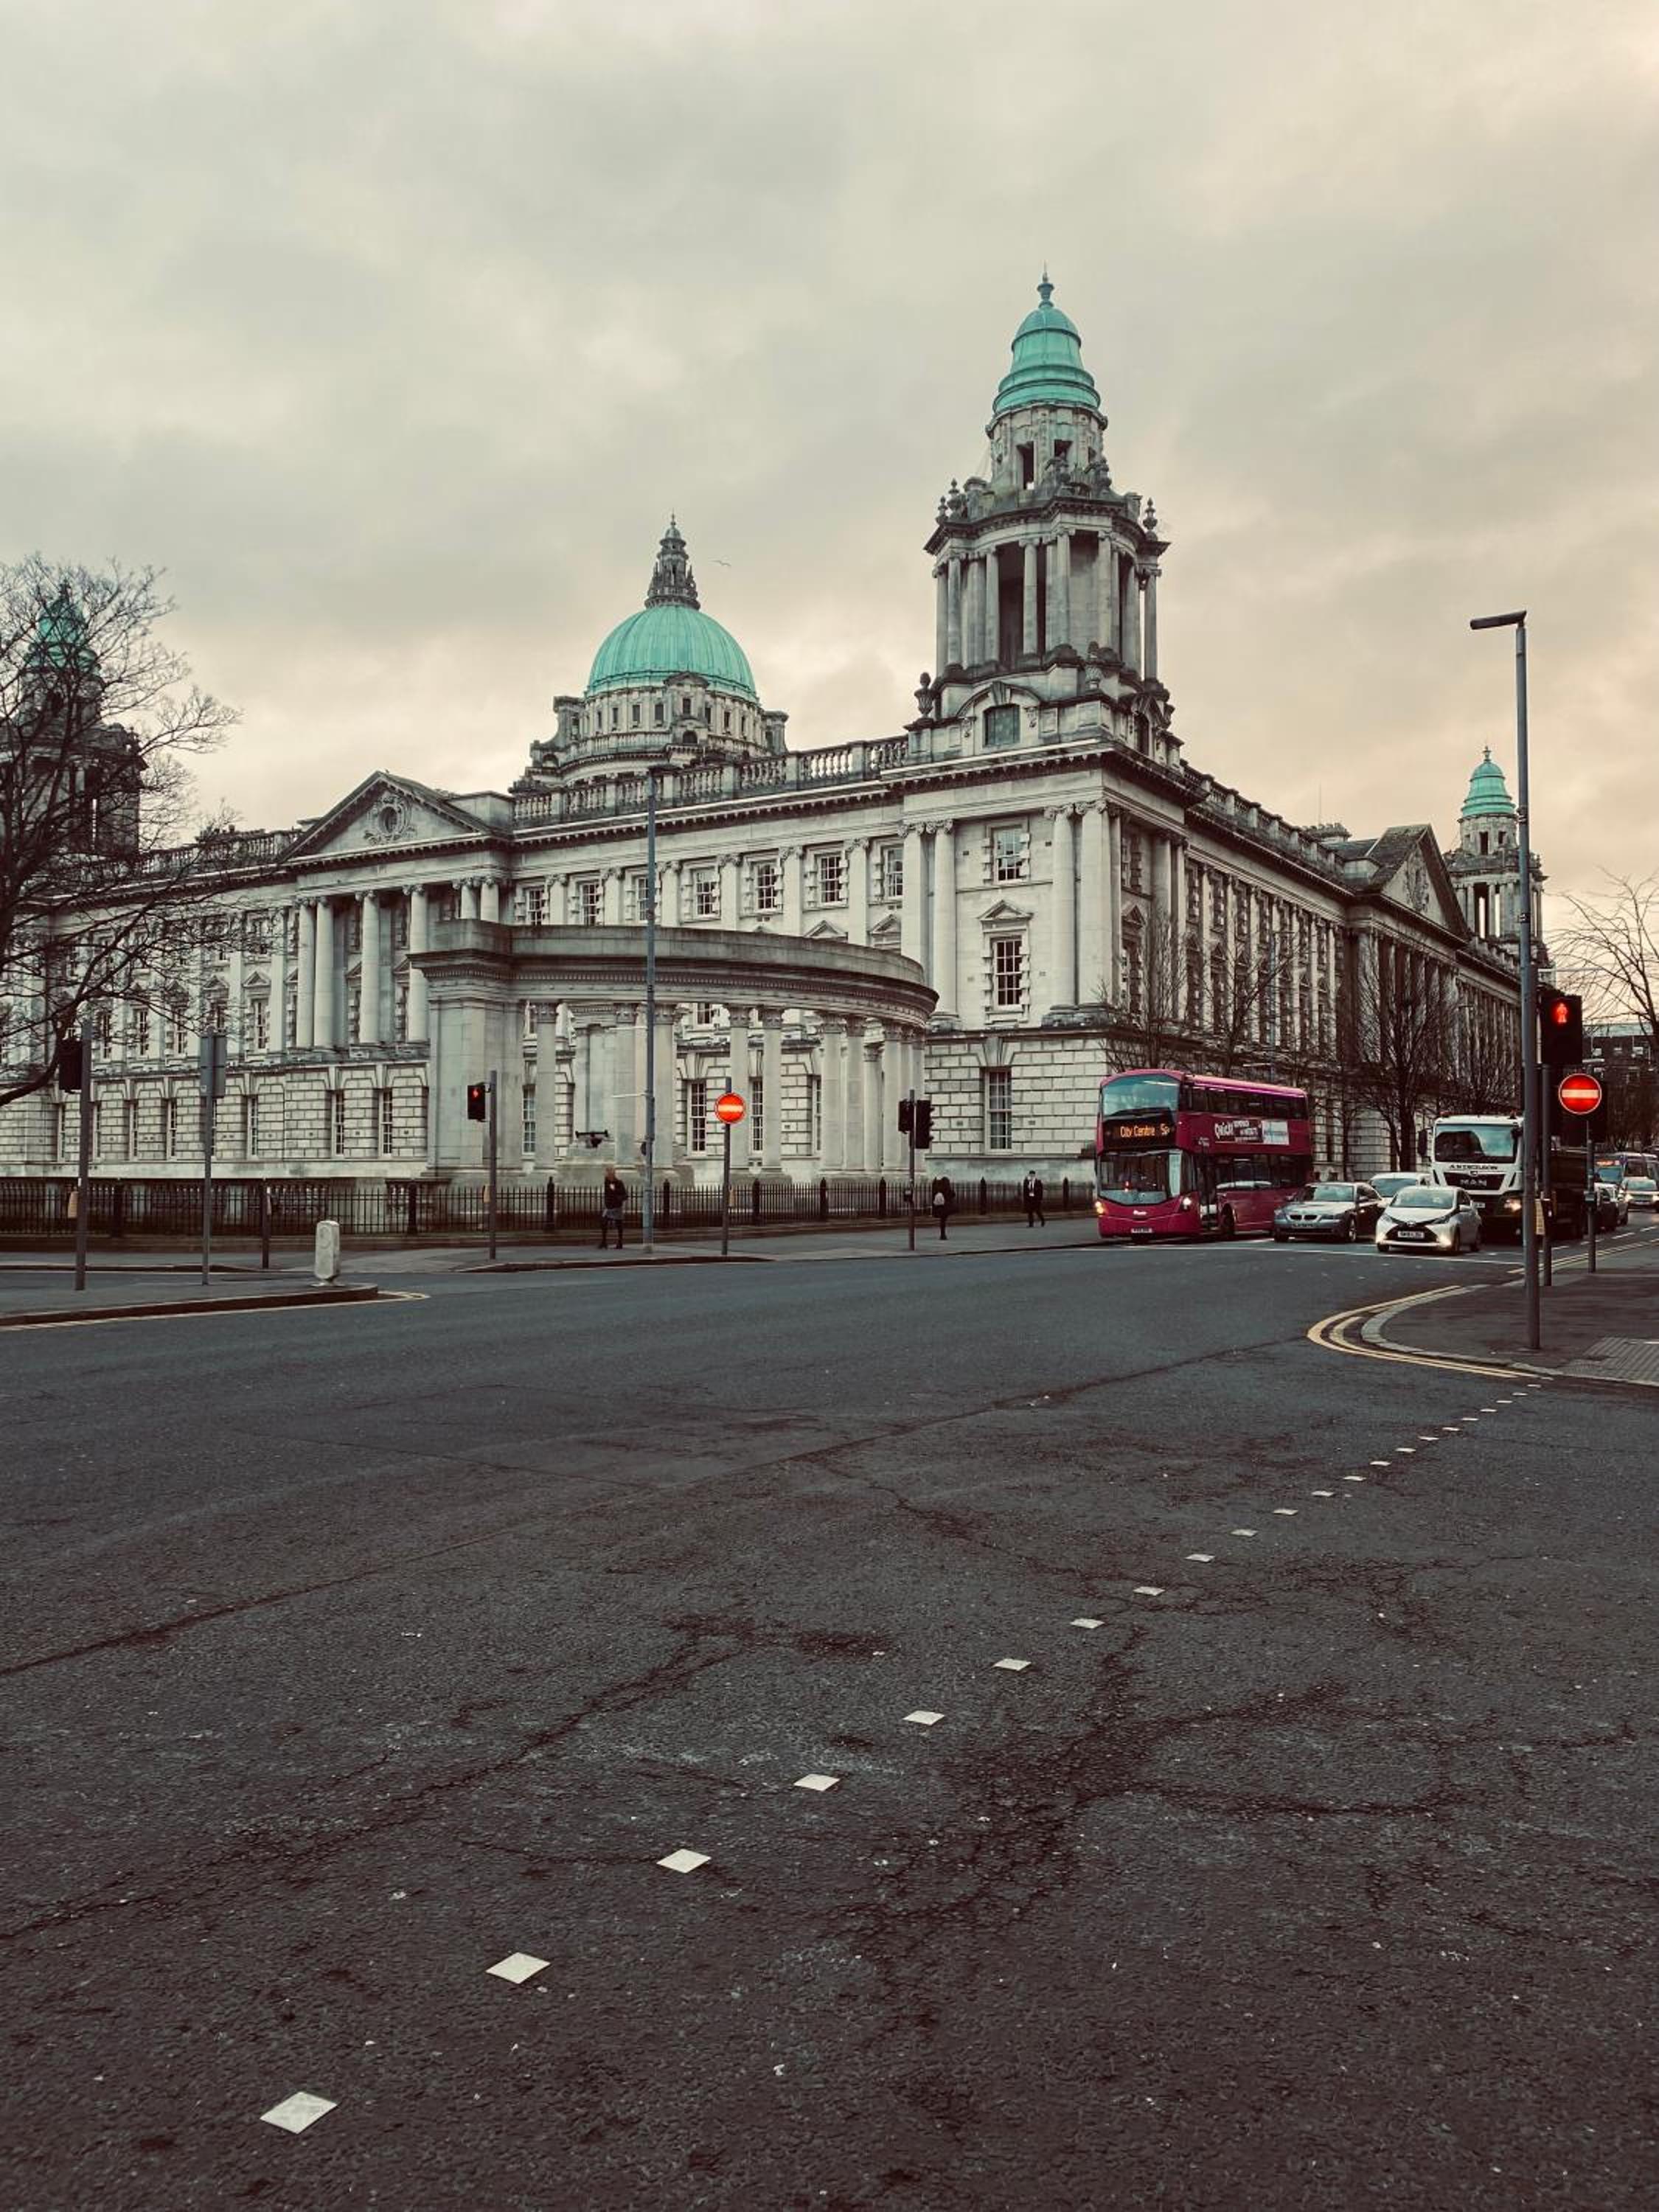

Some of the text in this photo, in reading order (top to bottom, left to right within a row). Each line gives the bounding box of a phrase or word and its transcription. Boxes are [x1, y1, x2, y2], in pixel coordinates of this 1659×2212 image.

[1120, 1126, 1133, 1138] City
[1133, 1125, 1155, 1137] Centre
[1459, 1179, 1487, 1187] MAN
